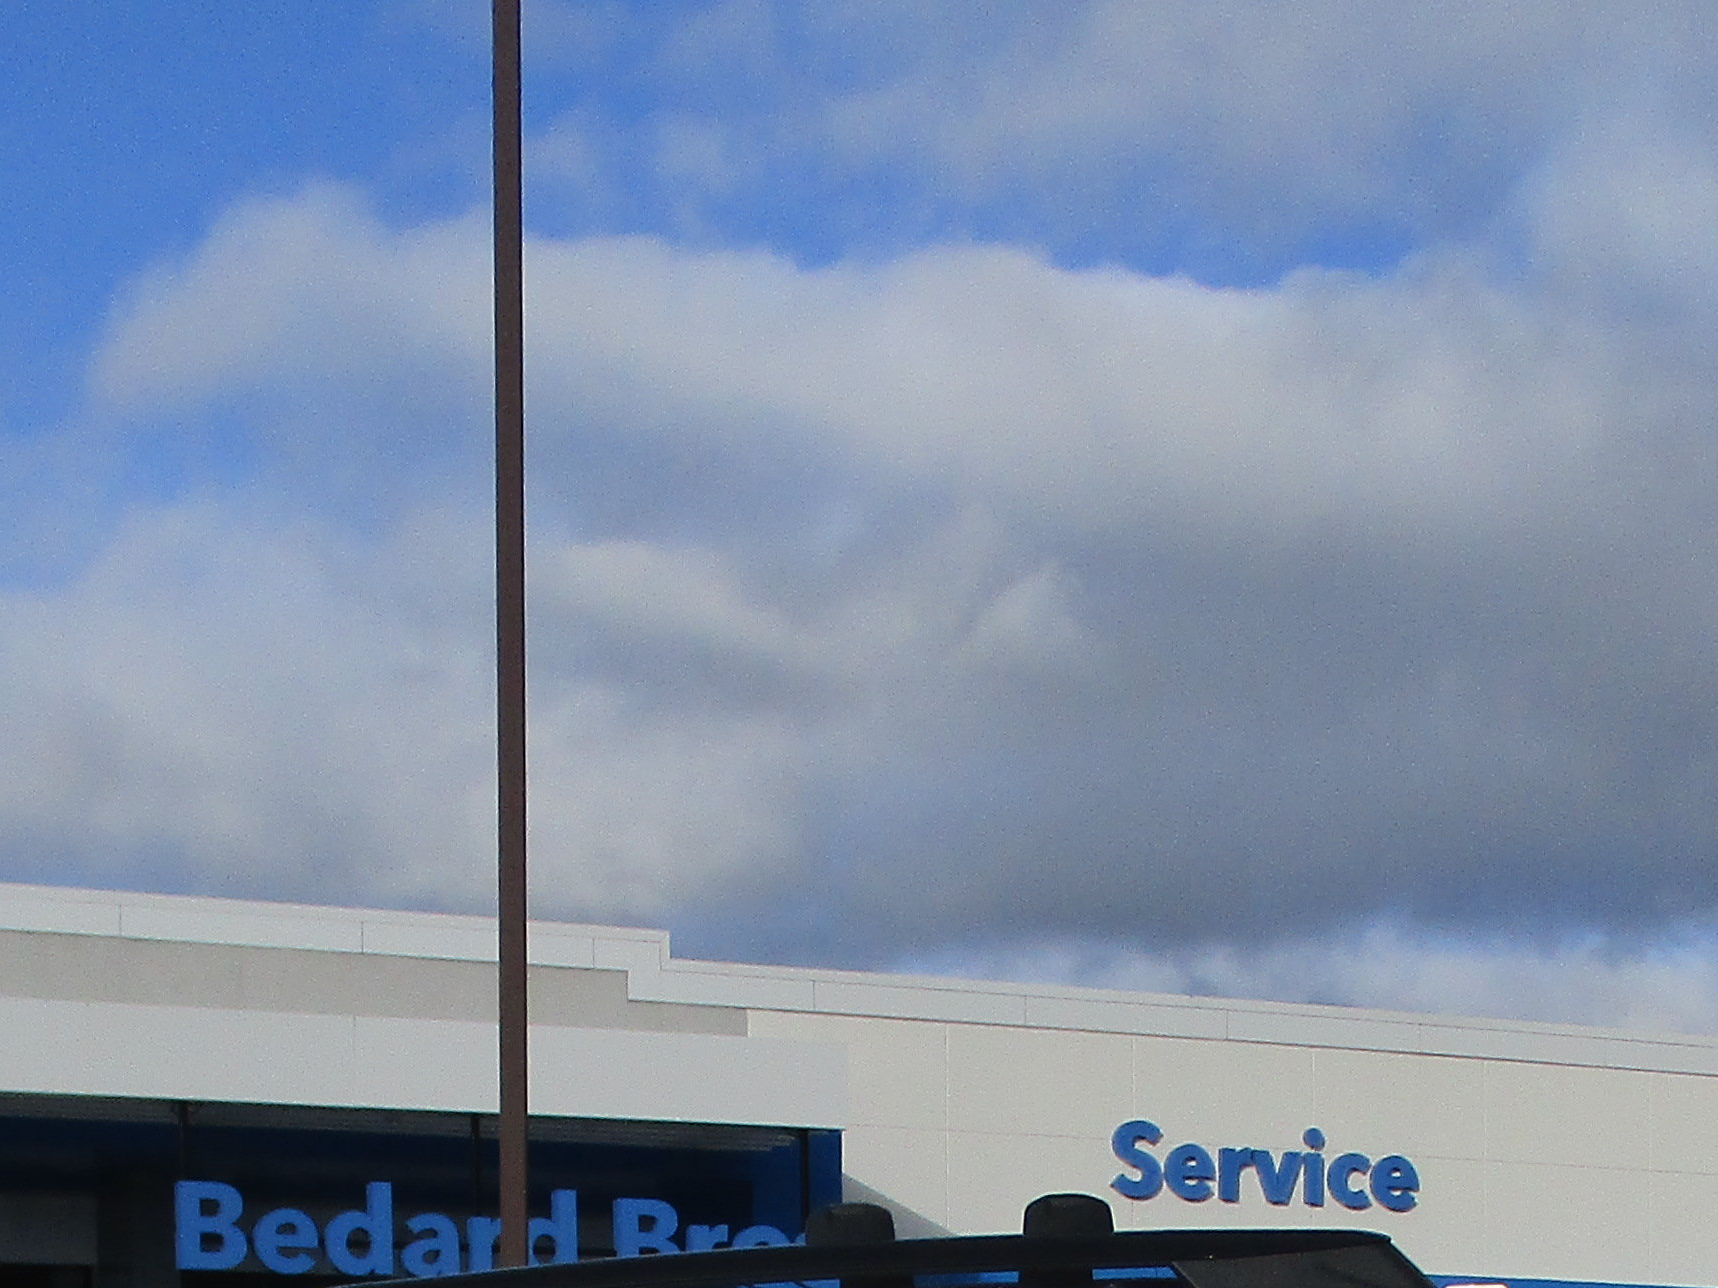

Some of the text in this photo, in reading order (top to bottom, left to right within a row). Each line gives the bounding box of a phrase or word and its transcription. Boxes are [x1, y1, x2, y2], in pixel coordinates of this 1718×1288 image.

[1109, 1119, 1421, 1213] Service
[174, 1180, 807, 1276] Bedard Br
